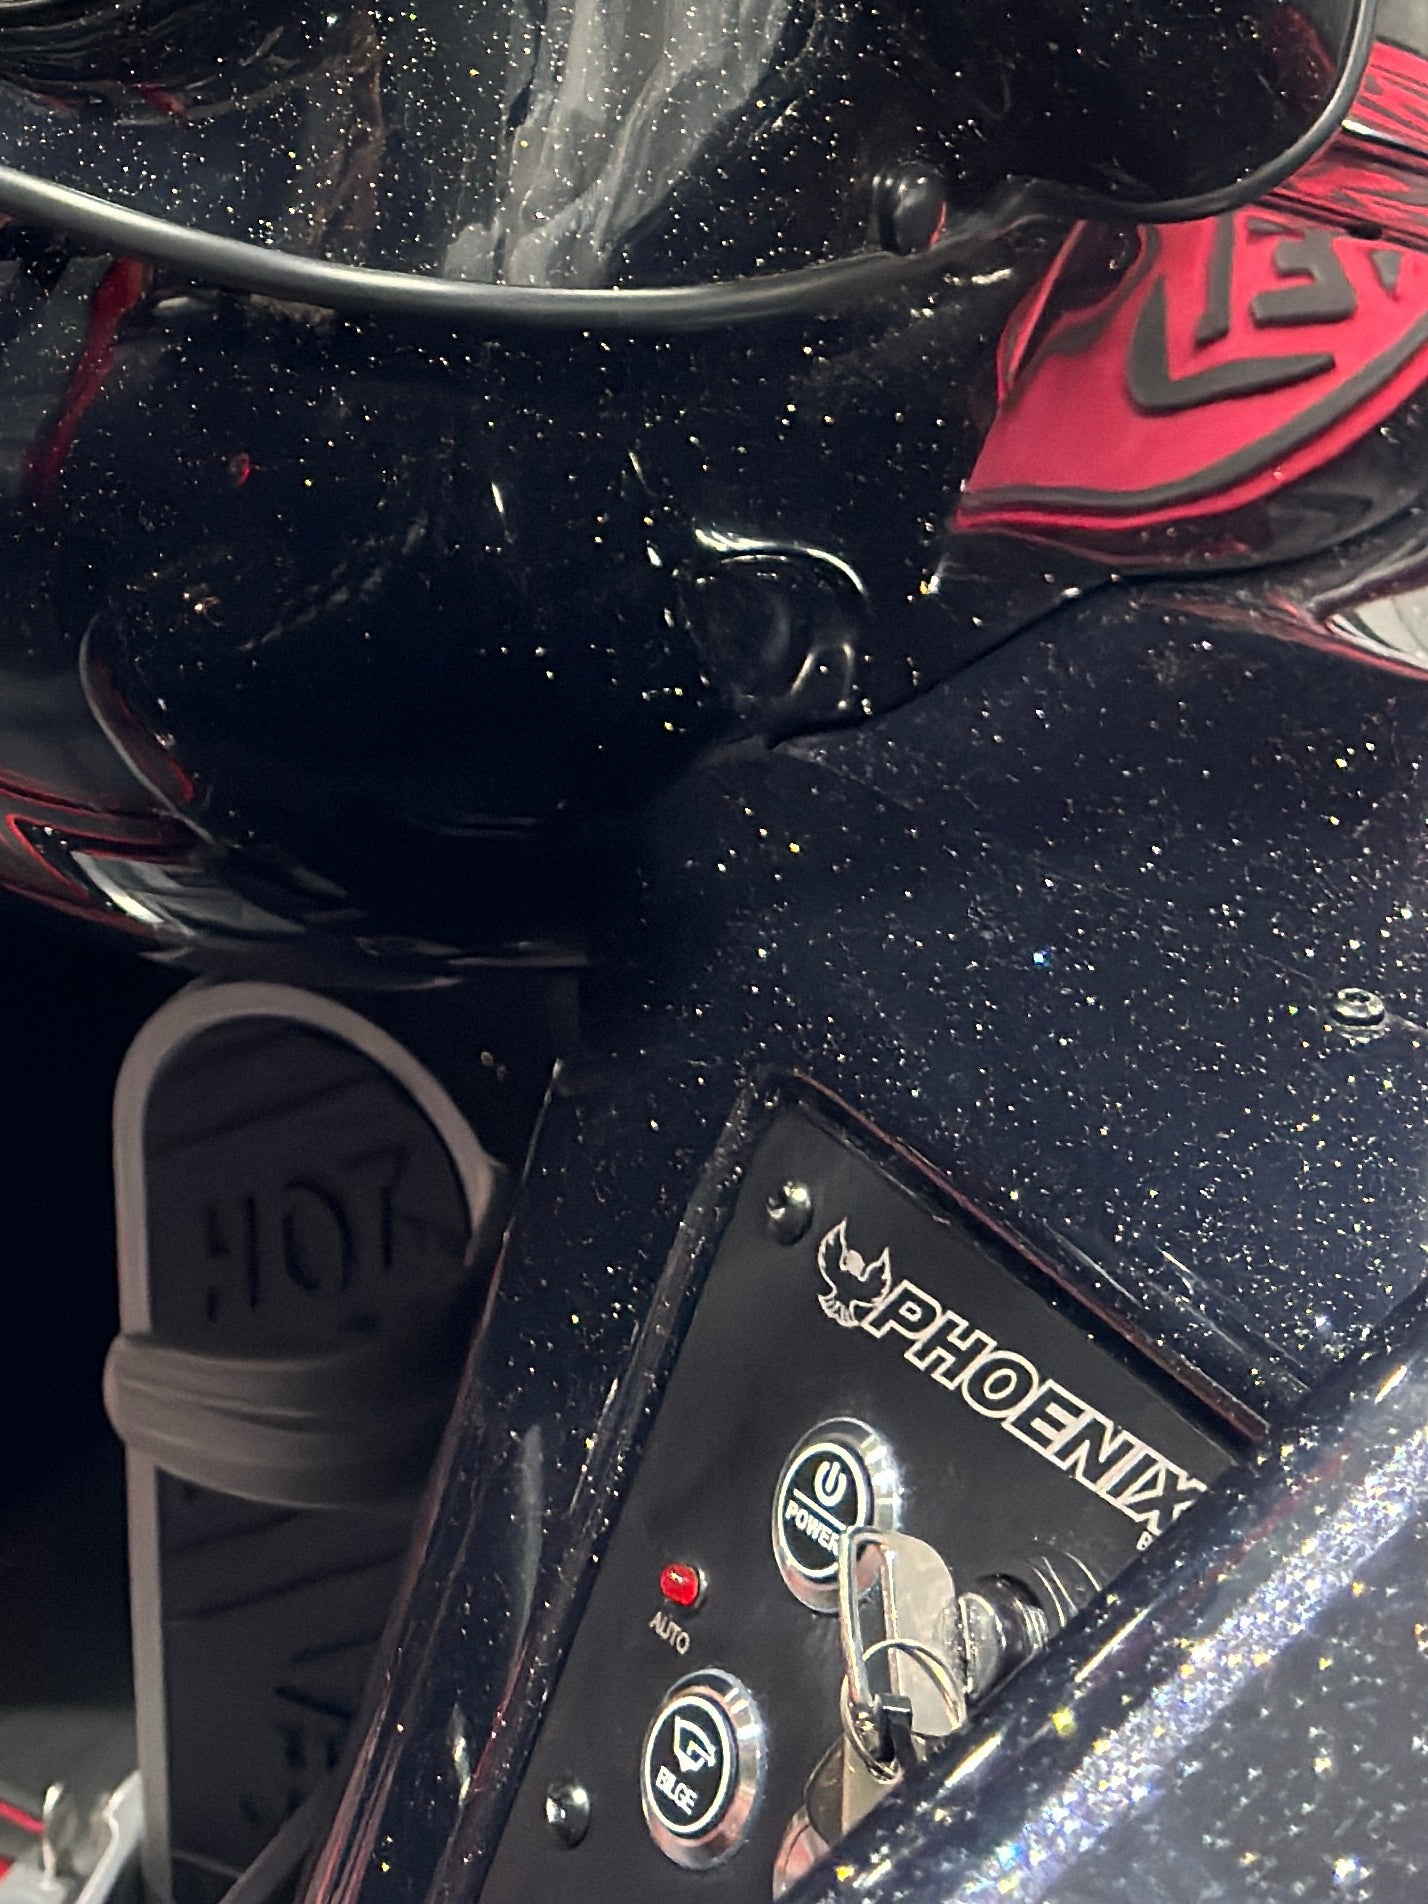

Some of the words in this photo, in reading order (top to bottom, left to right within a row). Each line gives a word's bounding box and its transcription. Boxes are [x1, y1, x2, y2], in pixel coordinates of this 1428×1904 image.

[860, 1279, 1207, 1537] PHOENIX
[785, 1499, 839, 1556] POWER
[649, 1610, 690, 1655] AUTO
[655, 1764, 698, 1816] BILGE
